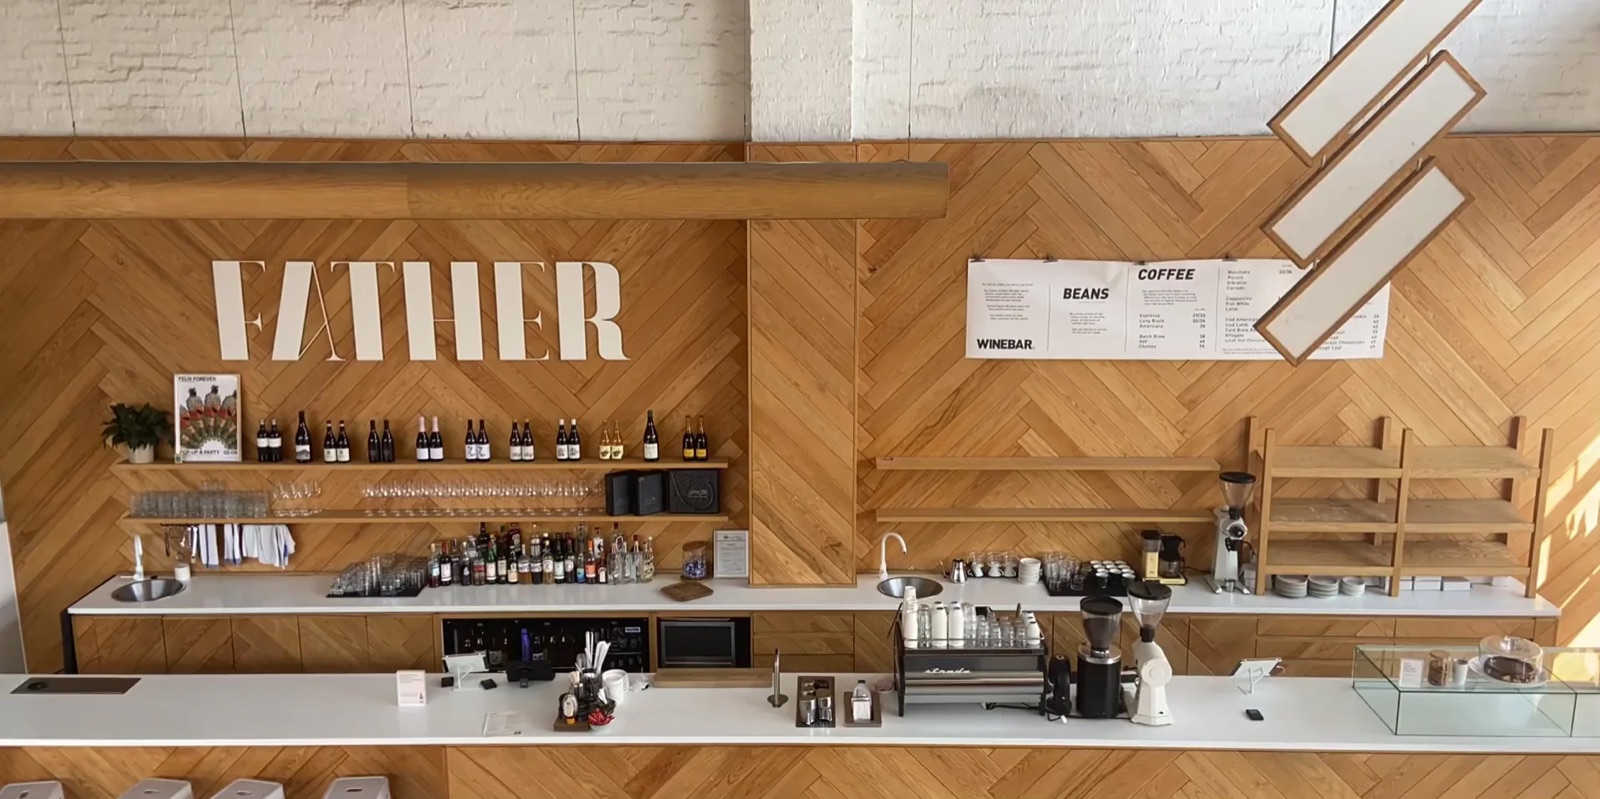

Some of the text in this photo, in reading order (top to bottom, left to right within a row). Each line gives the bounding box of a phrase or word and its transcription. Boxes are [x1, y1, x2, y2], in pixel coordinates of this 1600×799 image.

[1138, 268, 1196, 281] COFFEE
[1063, 287, 1110, 300] BEANS
[212, 260, 631, 361] FATHER
[976, 338, 1033, 350] WINEBAR
